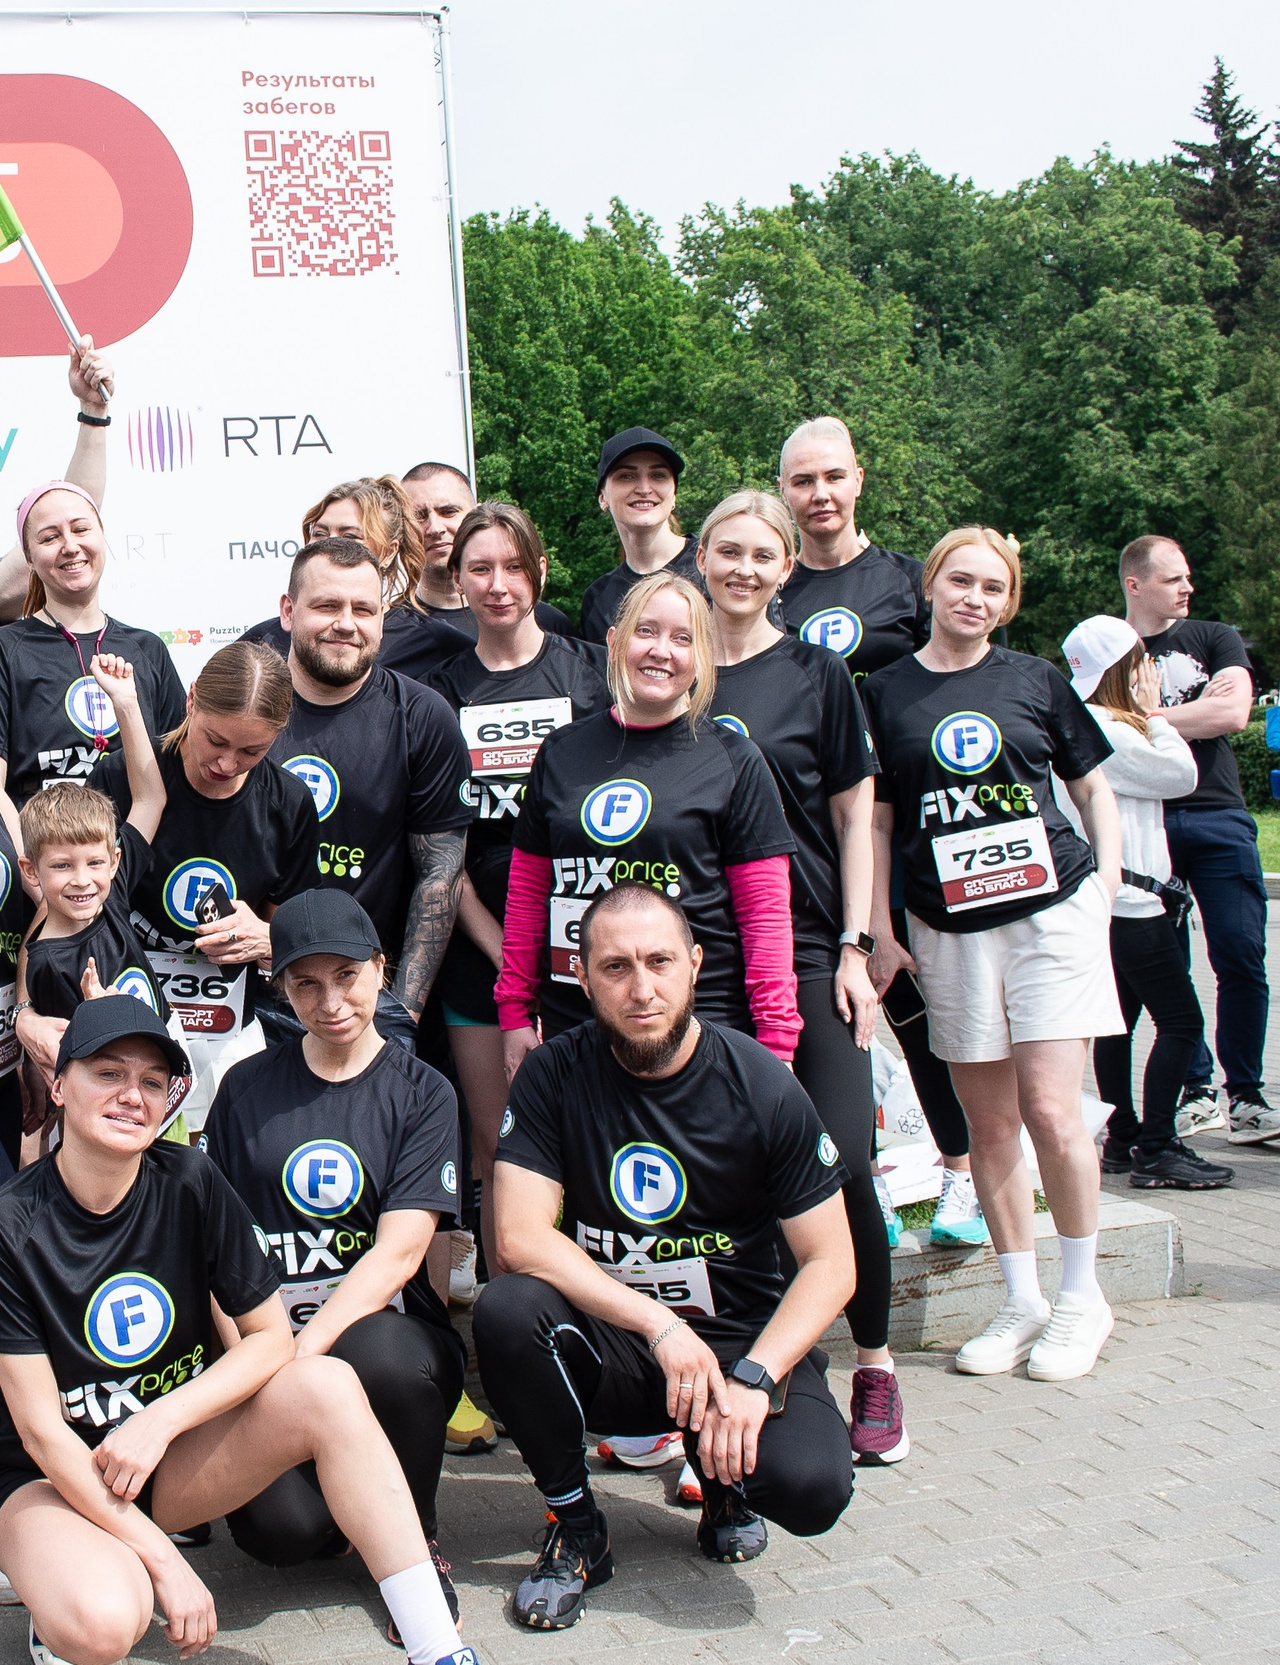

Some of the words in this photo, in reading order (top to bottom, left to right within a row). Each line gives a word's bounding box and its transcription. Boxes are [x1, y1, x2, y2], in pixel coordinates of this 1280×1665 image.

[242, 70, 375, 92] Результаты
[243, 97, 336, 115] забегов
[223, 413, 333, 457] RTA
[209, 626, 241, 635] Puzzle
[477, 717, 557, 743] 635
[483, 758, 502, 767] ВО
[952, 838, 1033, 872] 735
[963, 869, 1027, 890] СПОРТ
[965, 888, 985, 898] ВО
[985, 878, 1029, 897] БЛАГО
